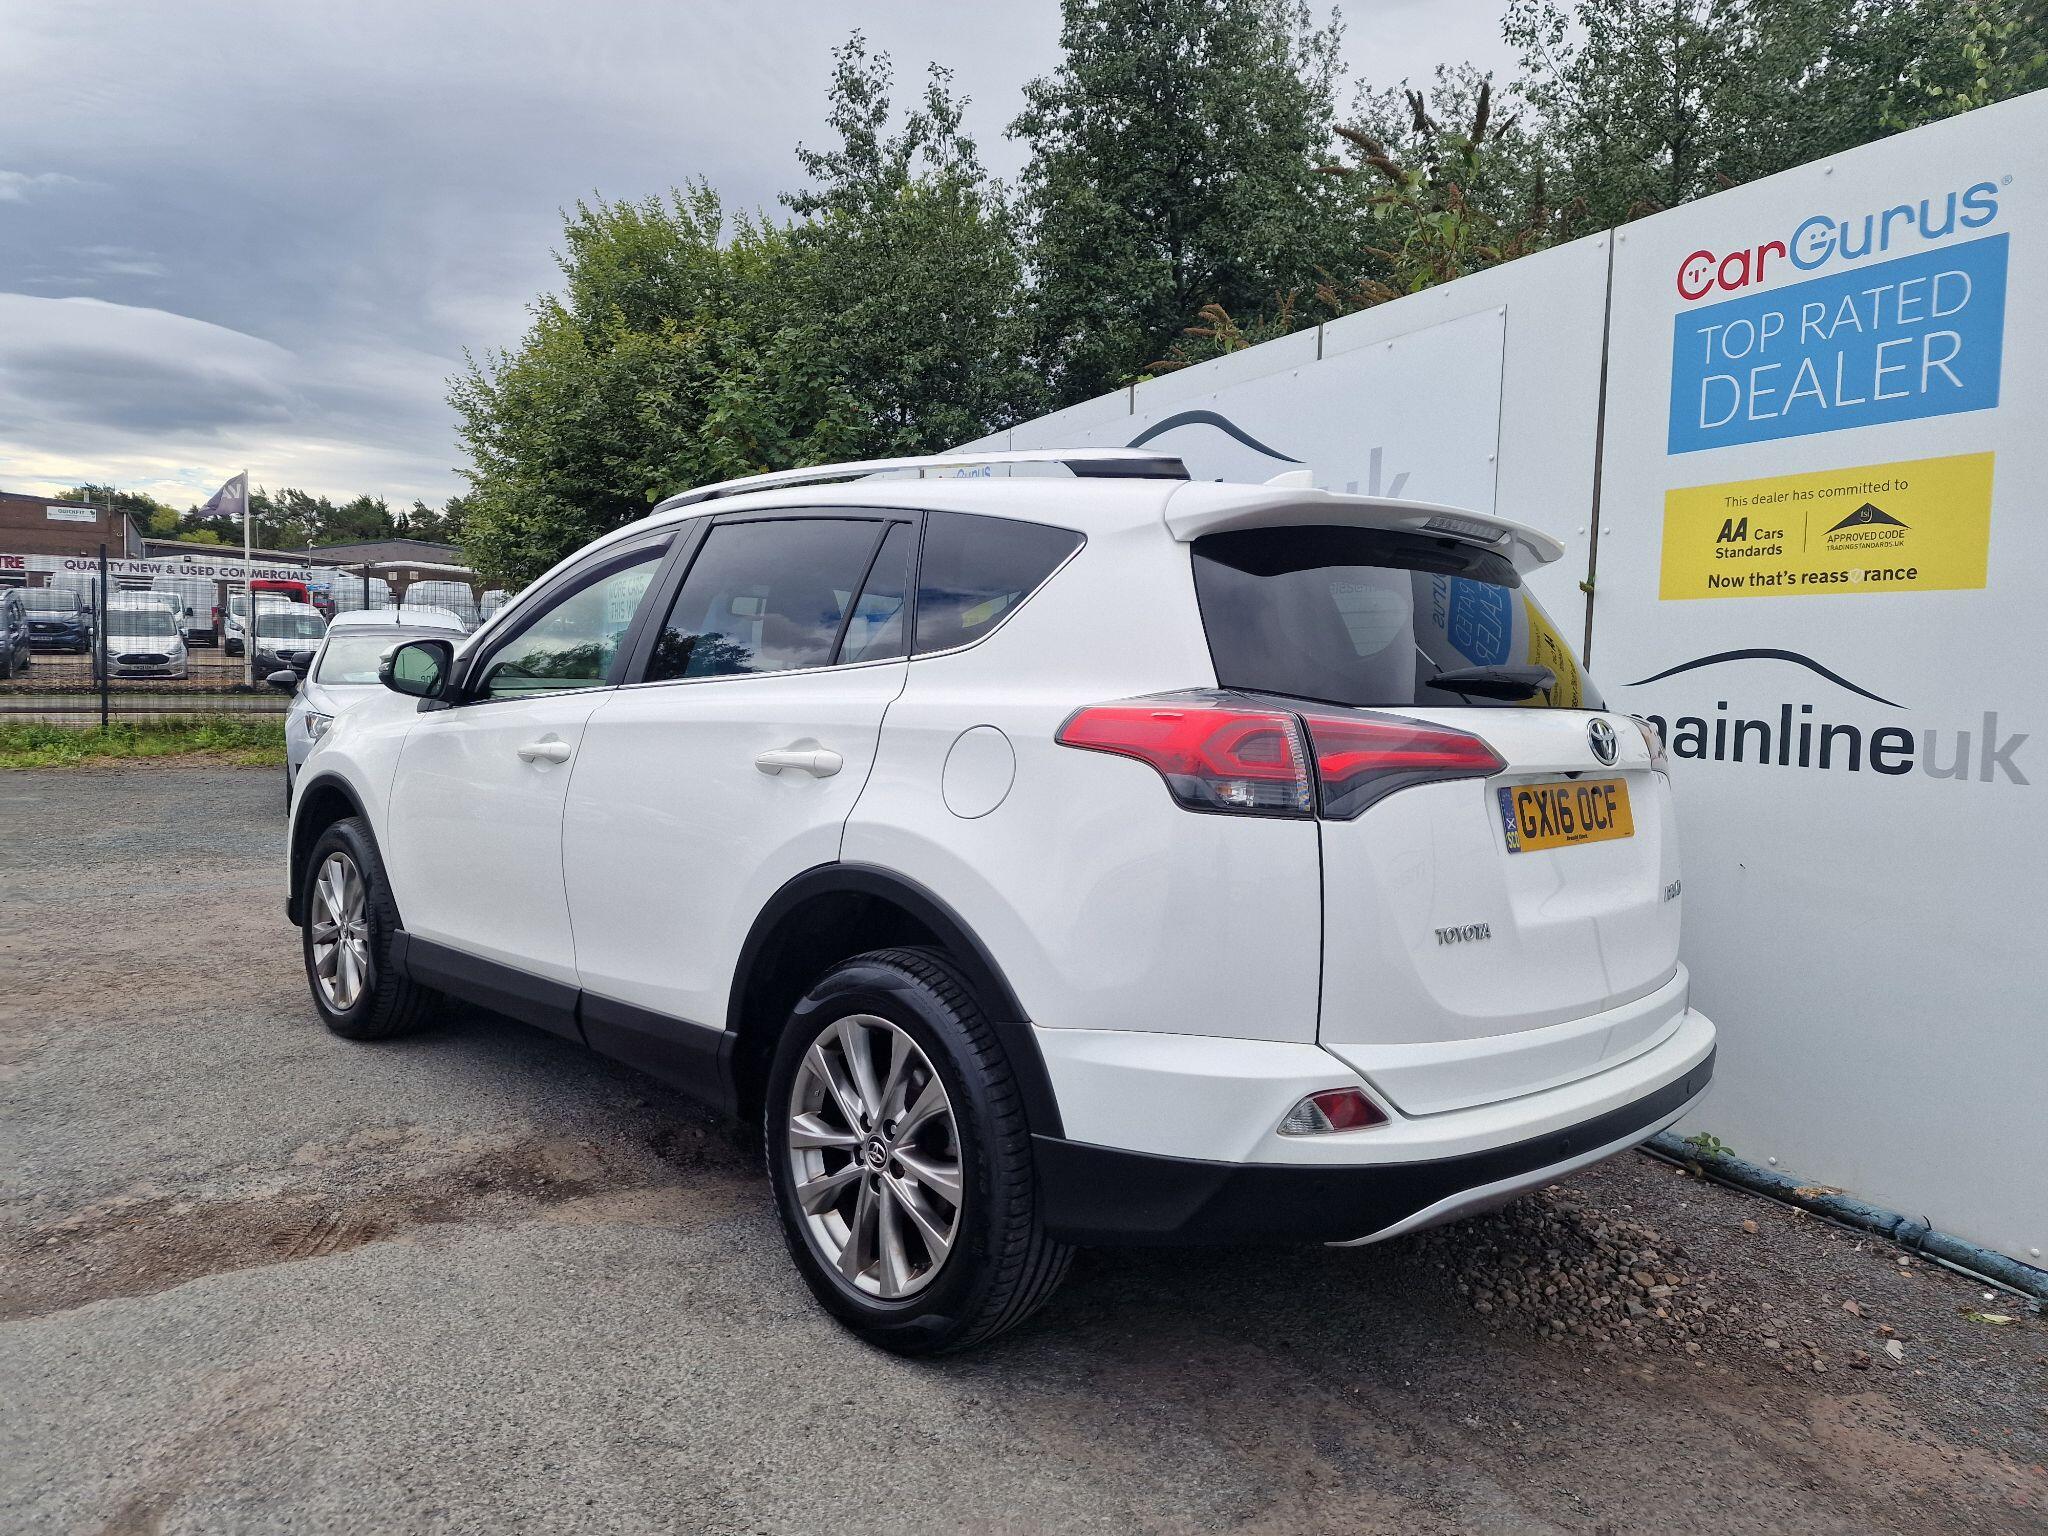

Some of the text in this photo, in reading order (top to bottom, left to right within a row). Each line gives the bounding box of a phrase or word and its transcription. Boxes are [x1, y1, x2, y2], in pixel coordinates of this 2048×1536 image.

[1697, 270, 1972, 365] TOP RATED
[1699, 330, 1964, 430] DEALER
[1725, 479, 1909, 508] This dealer has committed to
[1716, 516, 1784, 543] AA Cars
[1827, 529, 1905, 543] APPROVED CODE
[1715, 544, 1783, 559] Standards
[64, 559, 125, 572] QUATY
[129, 563, 161, 574] NEW
[165, 564, 176, 575] &
[179, 565, 215, 576] USED
[1708, 566, 1918, 589] Now that's reassrance
[1517, 784, 1617, 839] GX16 OCF
[1434, 922, 1491, 946] TOYOTA
